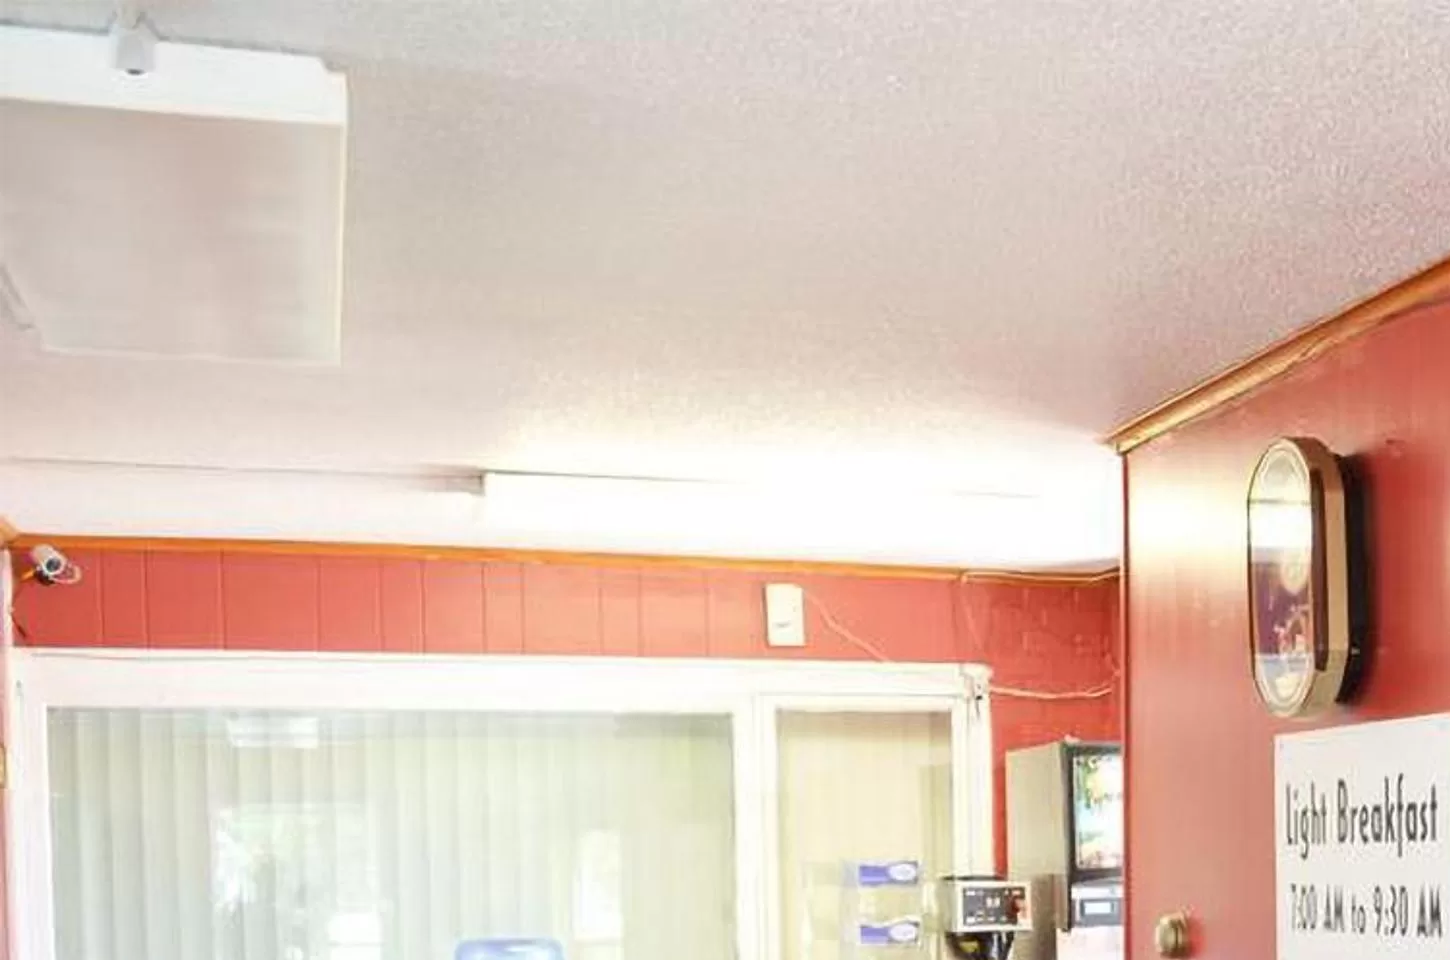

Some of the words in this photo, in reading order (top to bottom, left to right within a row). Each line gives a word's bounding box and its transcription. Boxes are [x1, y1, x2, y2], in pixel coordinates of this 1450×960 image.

[1286, 780, 1327, 860] Light
[1337, 772, 1438, 858] Breakfast
[1323, 884, 1345, 933] AM
[1351, 893, 1367, 934] to
[1374, 884, 1408, 936] 9:30
[1417, 883, 1443, 938] AM
